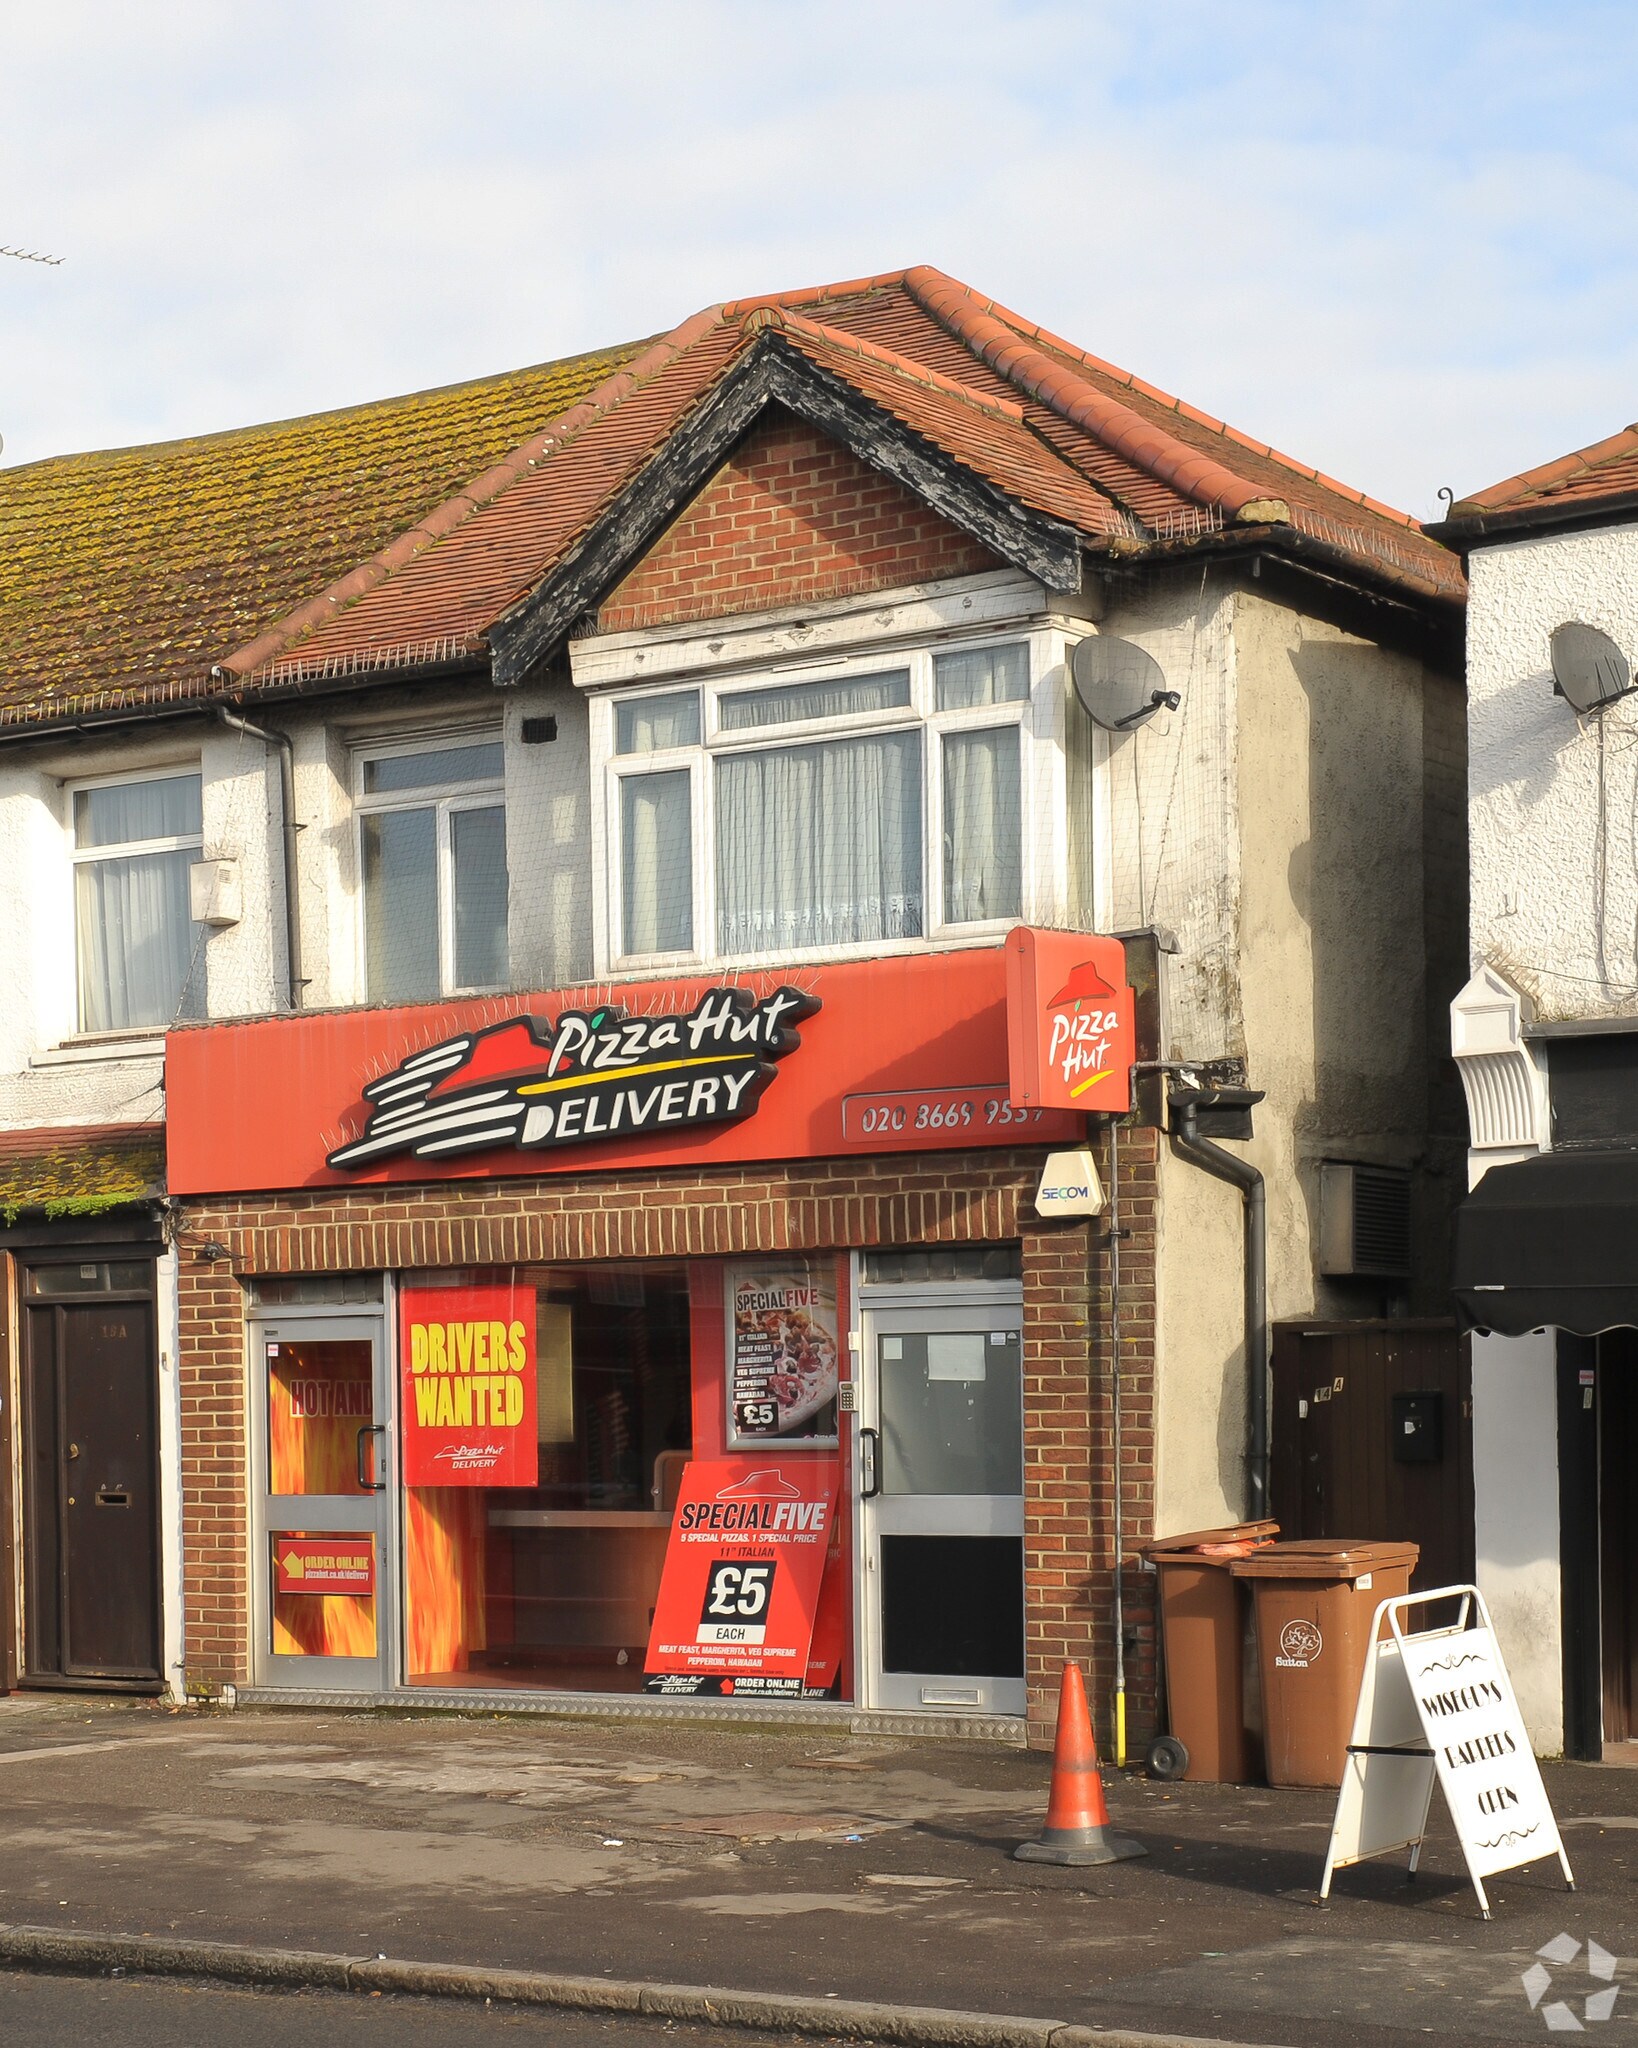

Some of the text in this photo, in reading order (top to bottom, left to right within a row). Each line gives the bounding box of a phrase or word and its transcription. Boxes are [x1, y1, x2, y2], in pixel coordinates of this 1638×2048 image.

[548, 994, 799, 1078] Pizza Hut
[1049, 1009, 1119, 1067] Pizza
[1062, 1039, 1111, 1083] Hut
[521, 1070, 756, 1144] DELIVERY
[862, 1106, 907, 1133] 020
[914, 1102, 975, 1129] 3669
[1041, 1186, 1089, 1200] SECOM
[410, 1320, 527, 1374] DRIVERS
[290, 1379, 330, 1417] HOT
[414, 1375, 524, 1427] WANTED
[743, 1404, 774, 1424] £5
[458, 1445, 505, 1455] Pizza Hut
[452, 1459, 497, 1469] DELIVERY
[680, 1534, 687, 1543] 5
[687, 1534, 719, 1543] SPECIAL
[752, 1534, 756, 1543] 1
[758, 1534, 791, 1543] SPECIAL
[793, 1534, 817, 1543] PRICE
[737, 1547, 775, 1558] ITALIAN
[304, 1555, 369, 1570] ORDER ONLINE
[708, 1566, 769, 1615] £5
[715, 1628, 746, 1640] EACH
[658, 1645, 677, 1654] MEAT
[748, 1648, 762, 1656] VEG
[762, 1648, 797, 1657] SUPREME
[1275, 1656, 1309, 1668] Sutton
[667, 1675, 705, 1684] Pizza Hut
[734, 1678, 800, 1689] ORDER ONLINE
[660, 1686, 698, 1694] DELIVERY
[1421, 1679, 1503, 1719] WISEGUYS
[1478, 1785, 1520, 1816] OPEN
